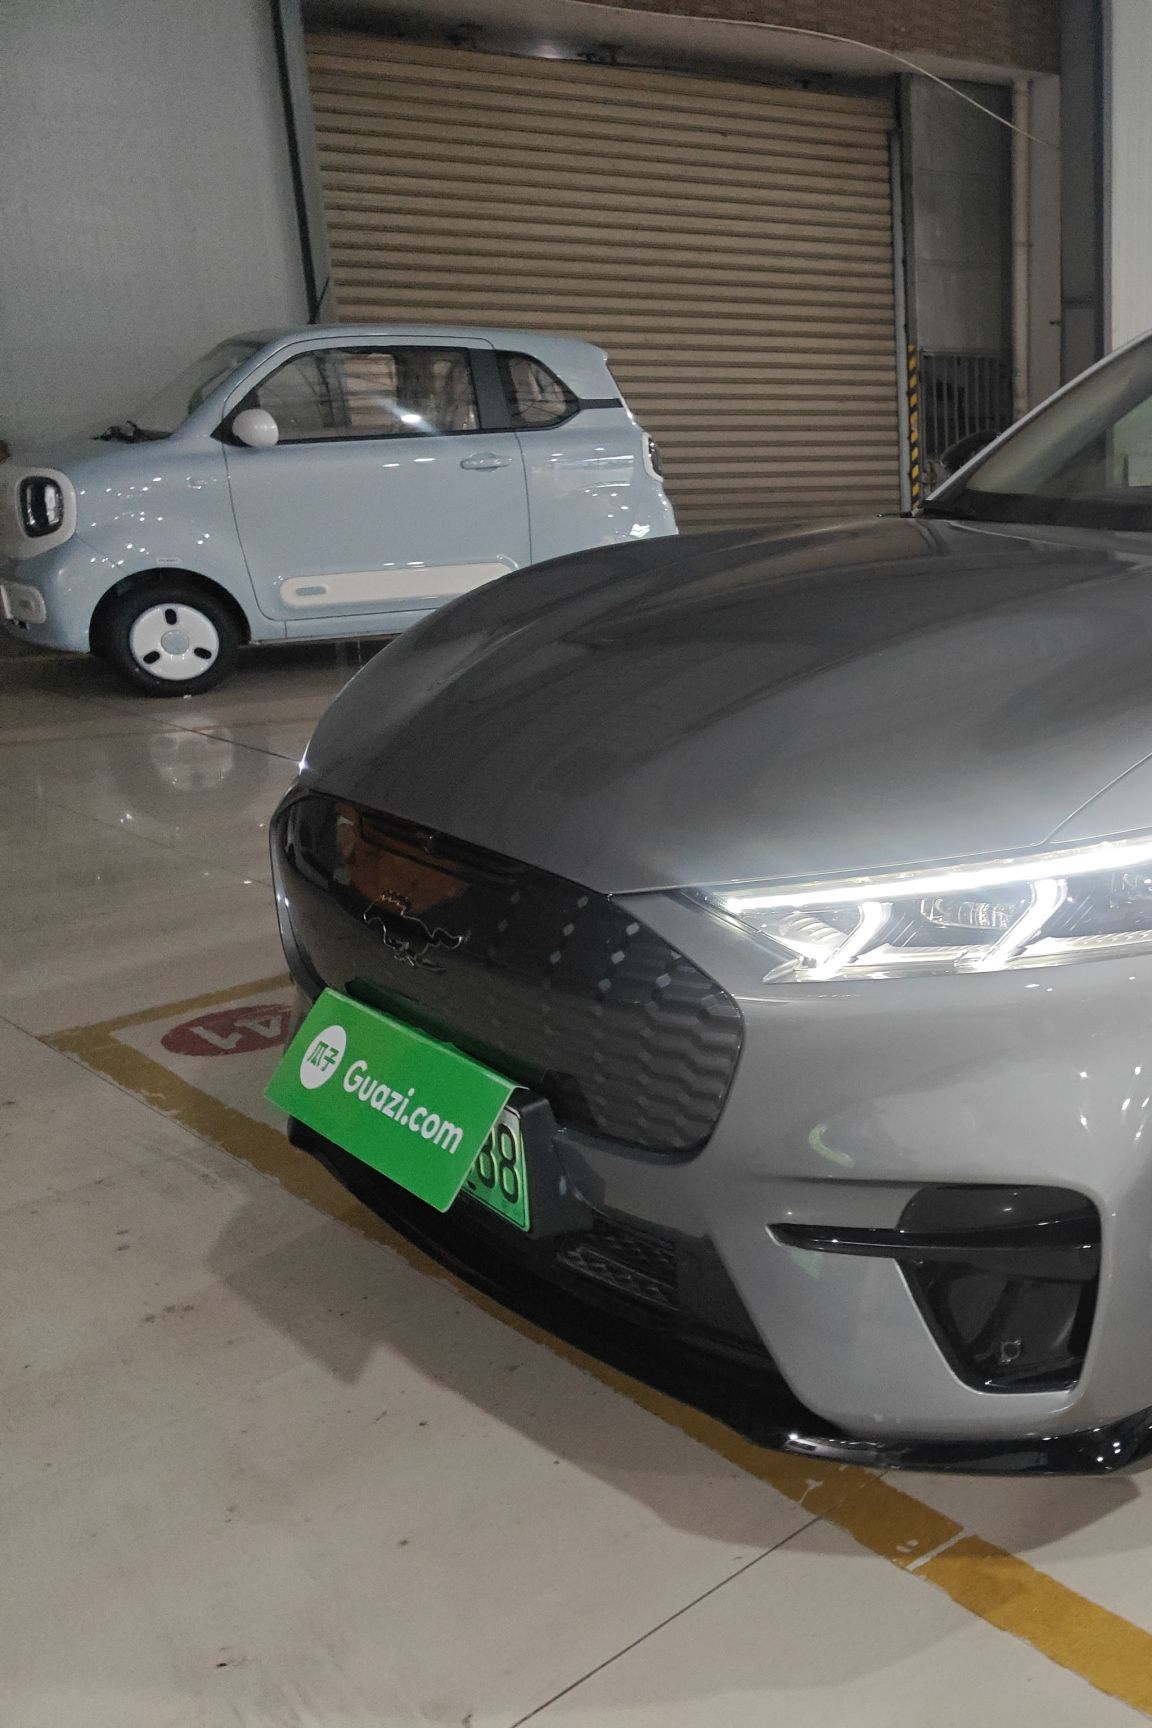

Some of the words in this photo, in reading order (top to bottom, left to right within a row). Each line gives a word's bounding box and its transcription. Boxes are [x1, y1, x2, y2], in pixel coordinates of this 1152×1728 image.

[306, 1040, 340, 1072] 瓜子
[342, 1059, 465, 1154] Guazi.com
[473, 1123, 520, 1205] 88
